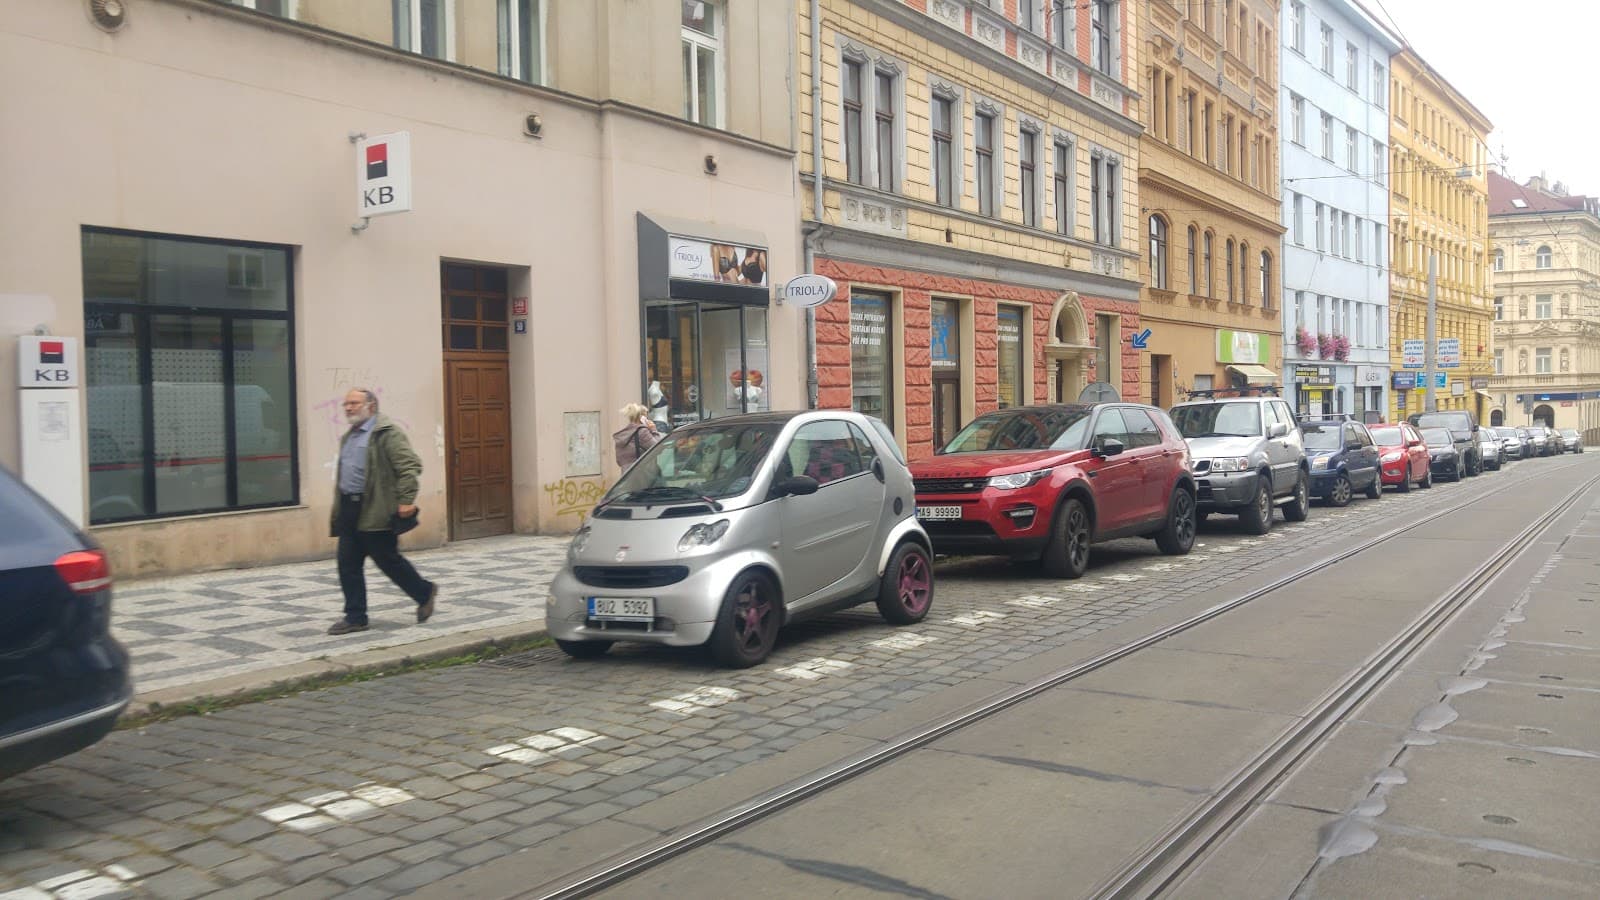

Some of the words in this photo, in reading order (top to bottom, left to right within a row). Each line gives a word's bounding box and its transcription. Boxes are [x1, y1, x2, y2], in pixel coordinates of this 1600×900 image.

[363, 186, 394, 208] KB
[676, 252, 700, 263] TRIOLA
[789, 286, 825, 297] TRIOLA
[35, 369, 70, 382] KB
[935, 507, 960, 517] 99999
